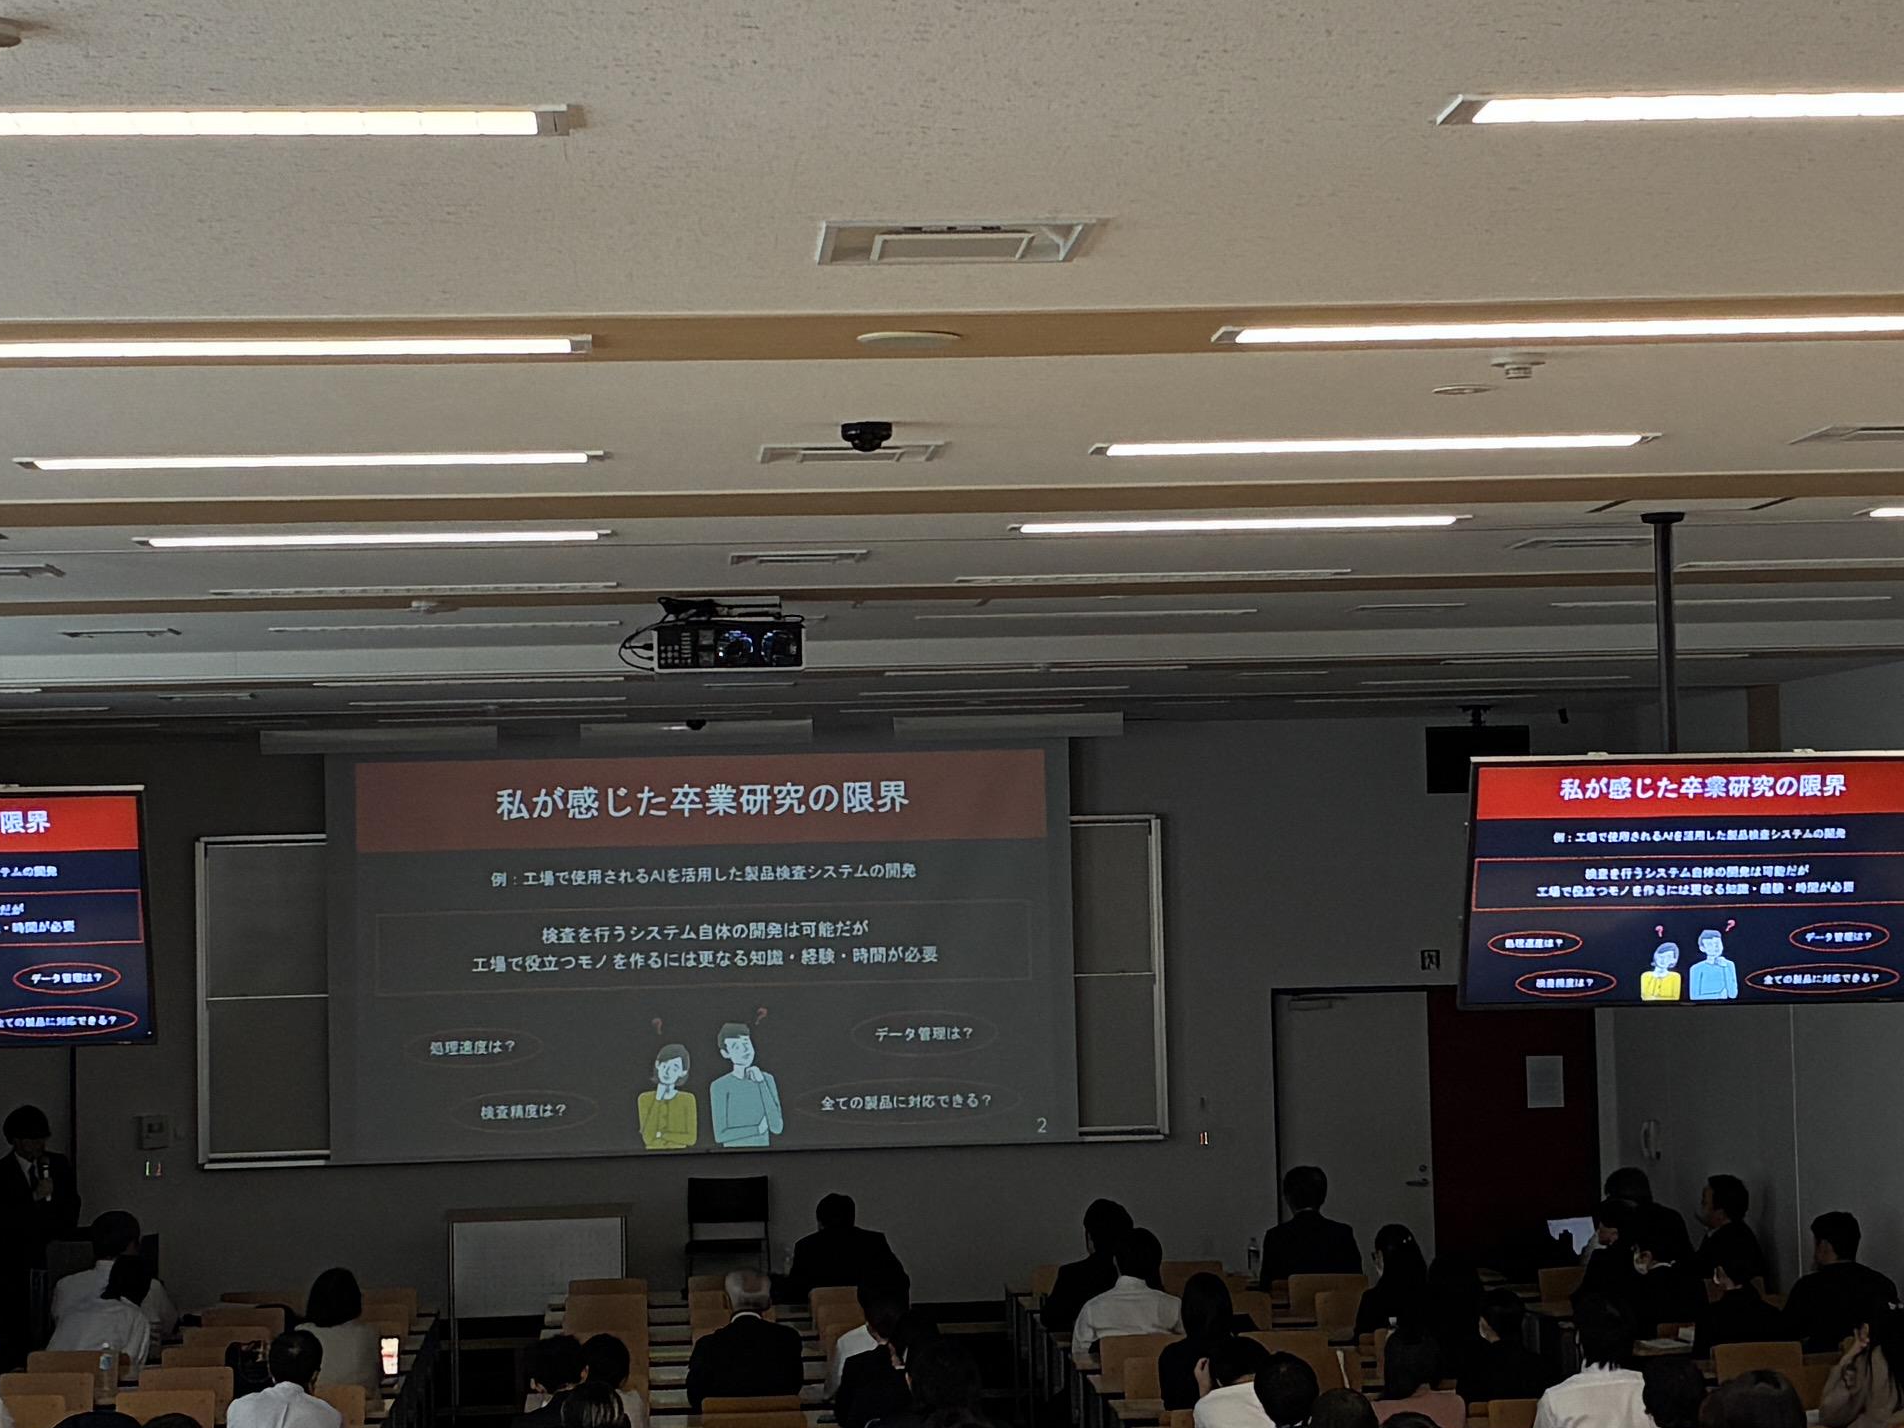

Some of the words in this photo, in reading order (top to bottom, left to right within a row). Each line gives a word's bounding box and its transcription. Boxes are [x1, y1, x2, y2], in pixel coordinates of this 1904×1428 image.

[1559, 774, 1847, 801] 私が感じた卒業研究の限界
[496, 780, 909, 821] 私が感じた卒業研究の限界
[490, 862, 917, 887] 例：工場で使用されるAIを活用した製品検査システムの開発
[542, 919, 869, 944] 検査を行うシステム自体の開発は可能だが
[875, 1026, 973, 1042] データ管理は？
[430, 1040, 515, 1056] 処理速度は？
[821, 1092, 991, 1111] 全ての製品に対応できる？
[480, 1104, 566, 1120] 検査精度は？
[1037, 1117, 1047, 1133] 2
